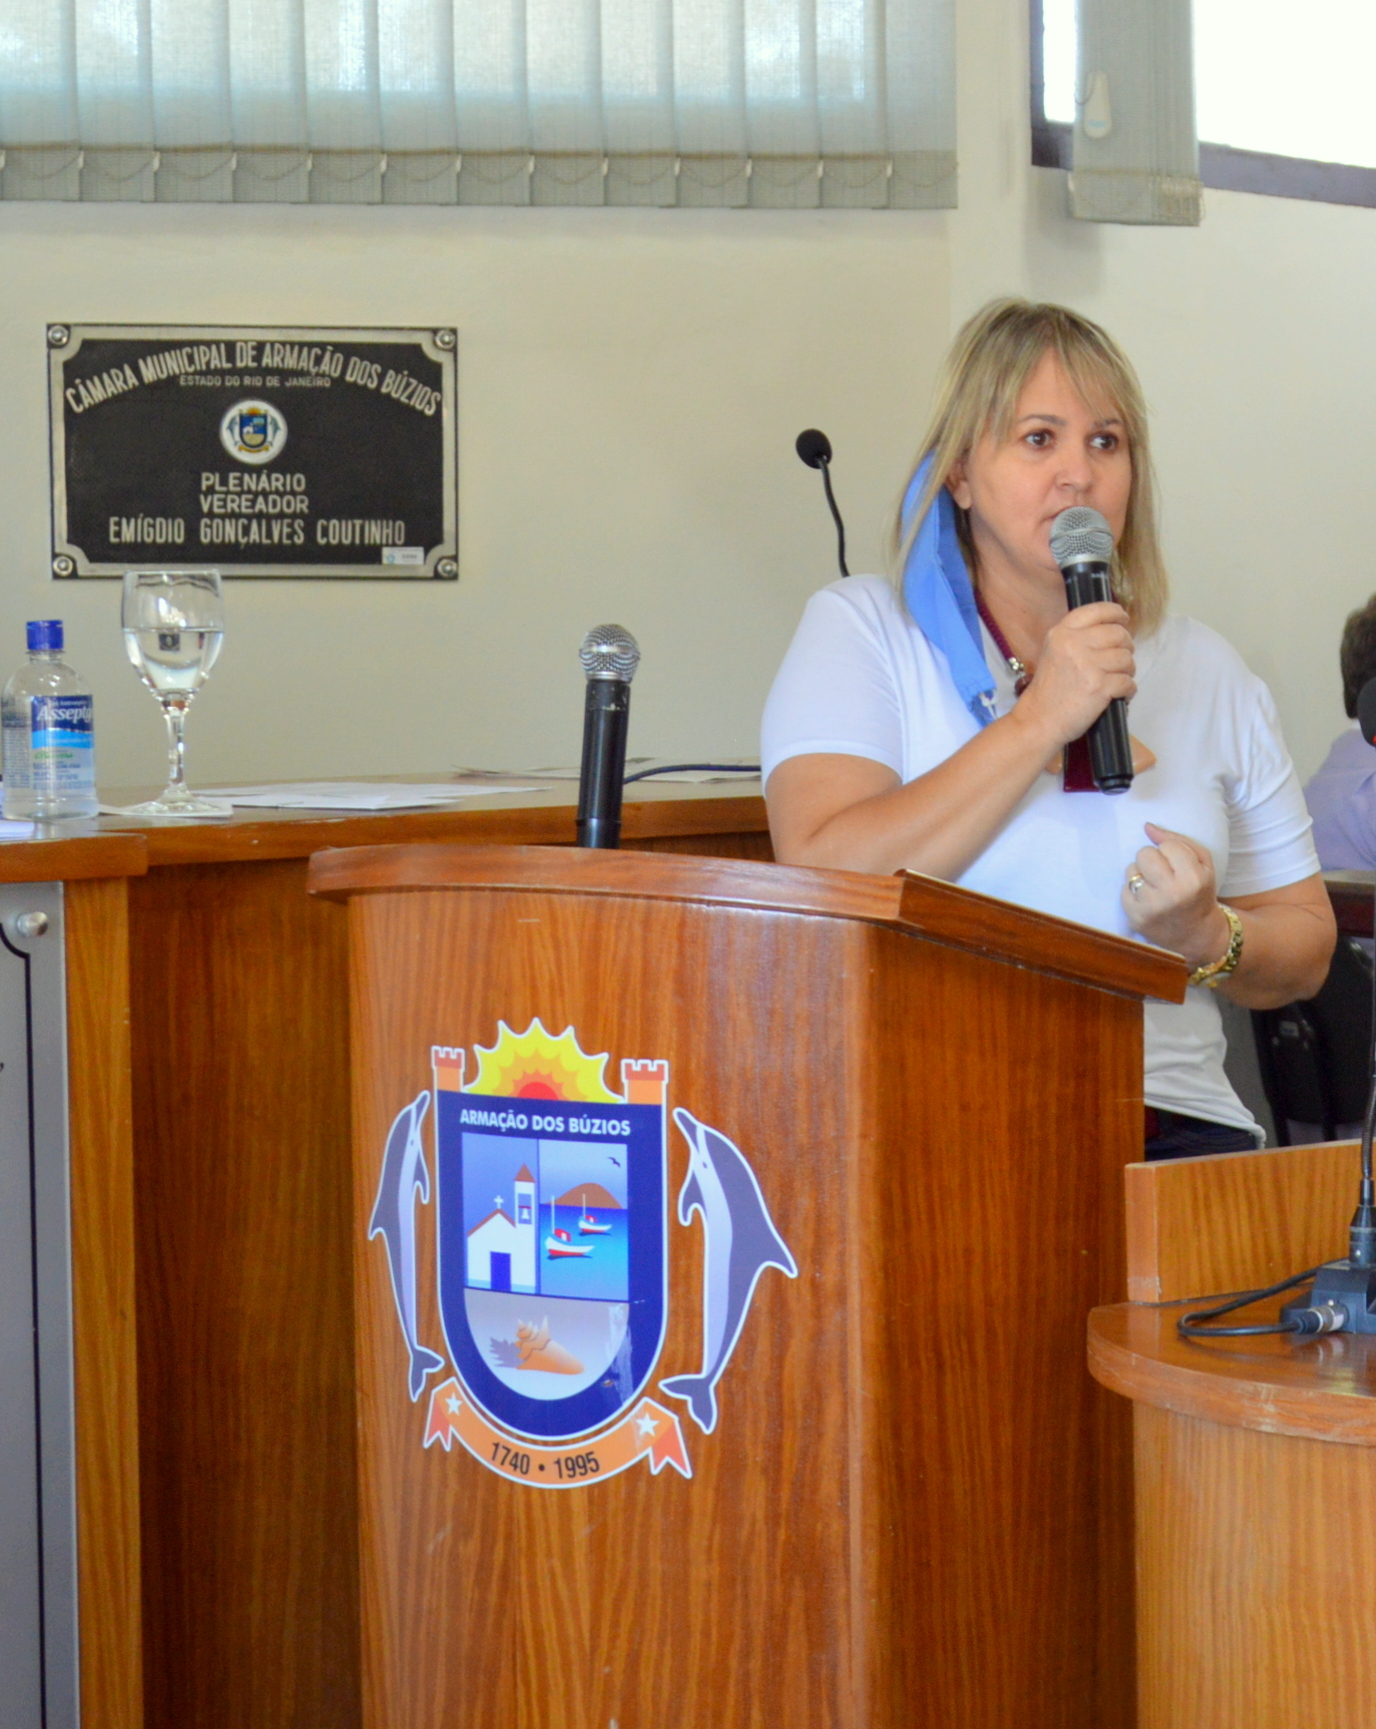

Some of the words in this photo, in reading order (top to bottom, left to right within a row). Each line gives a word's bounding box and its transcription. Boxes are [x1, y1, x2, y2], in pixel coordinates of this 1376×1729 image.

[65, 363, 139, 413] CÂMARA
[137, 342, 232, 384] MUNICIPAL
[235, 341, 258, 368] DE
[261, 342, 344, 378] ARMAÇÃO
[345, 356, 382, 390] DOS
[380, 370, 441, 417] BÚZIOS
[179, 375, 222, 387] ESTADO
[225, 375, 240, 387] DO
[243, 375, 263, 387] RIO
[266, 375, 281, 387] DE
[284, 375, 331, 387] JANEIRO
[201, 470, 306, 492] PLENÁRIO
[200, 494, 309, 514] VEREADOR
[109, 513, 185, 544] EMÍGDIO
[200, 517, 305, 549] GONÇALVES
[316, 519, 405, 545] COUTINHO
[460, 1109, 528, 1132] ARMAÇÃO
[532, 1115, 565, 1132] DOS
[568, 1114, 631, 1136] BÚZIOS
[492, 1442, 531, 1475] 1740
[553, 1451, 600, 1479] 1995
